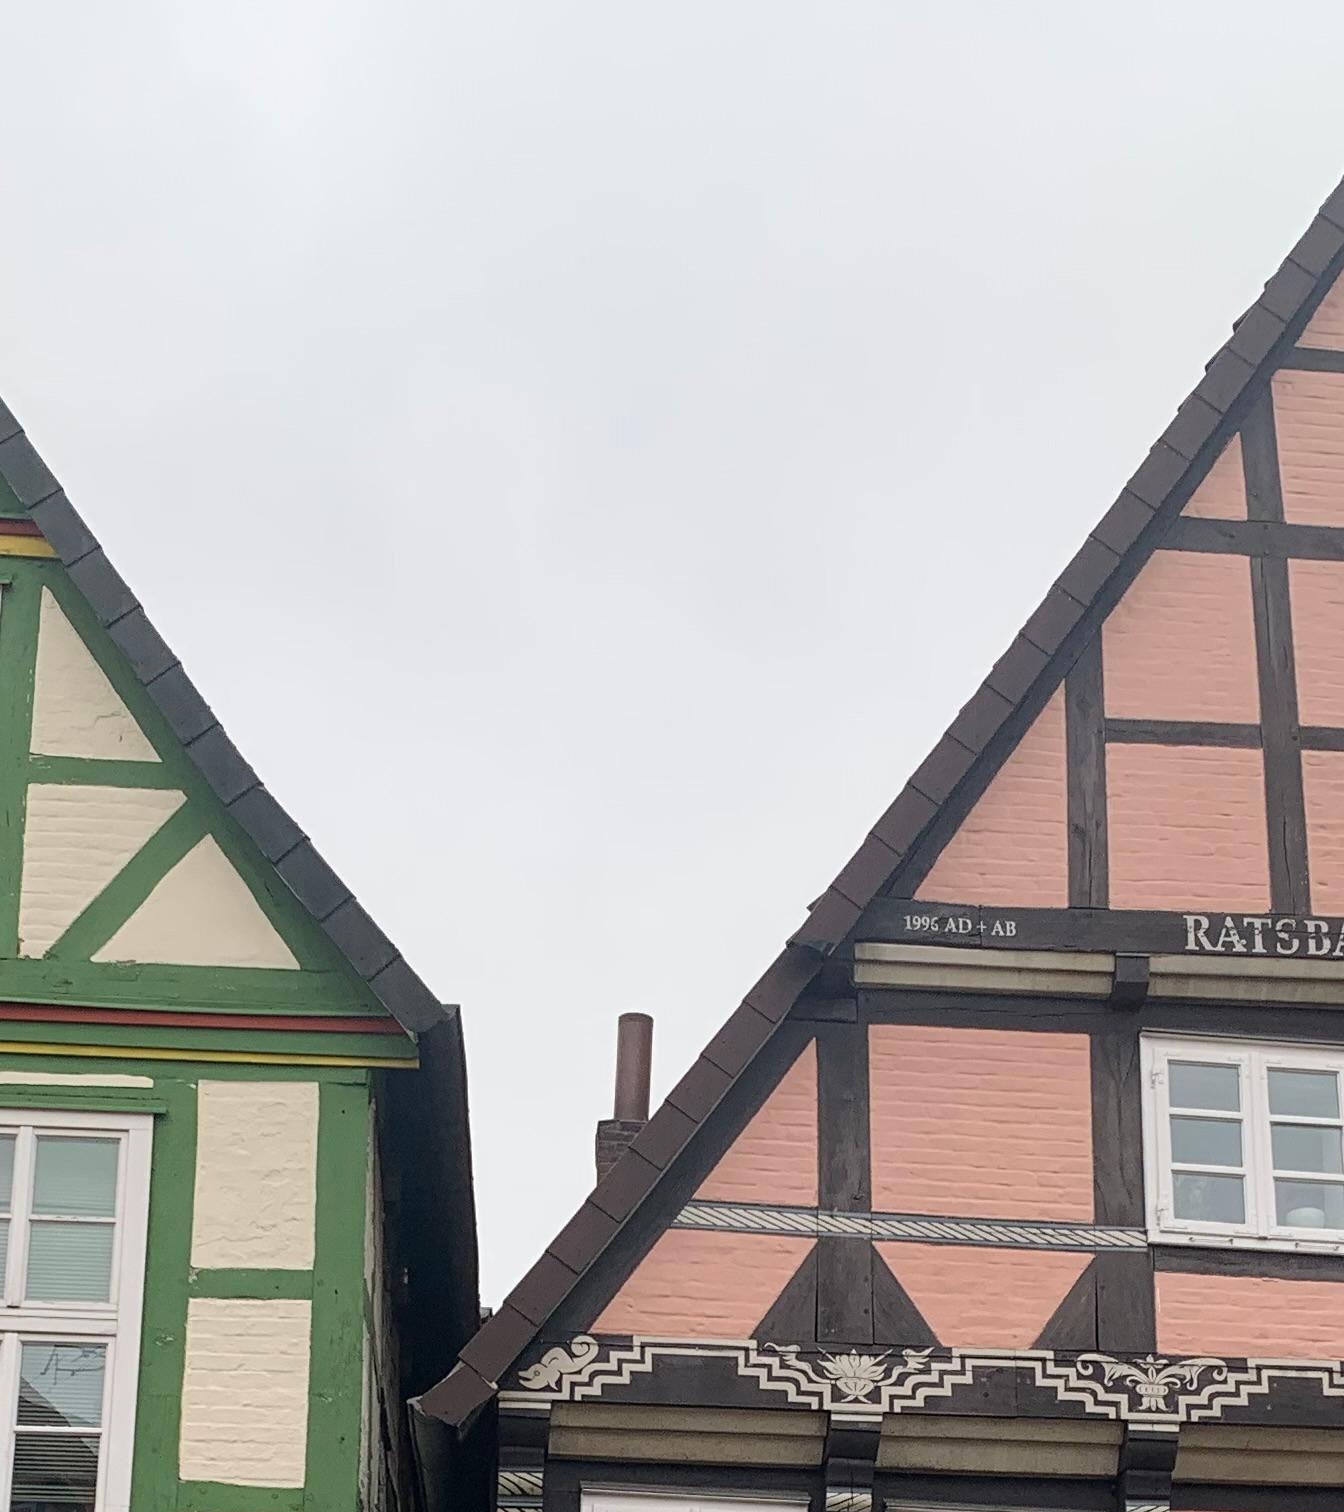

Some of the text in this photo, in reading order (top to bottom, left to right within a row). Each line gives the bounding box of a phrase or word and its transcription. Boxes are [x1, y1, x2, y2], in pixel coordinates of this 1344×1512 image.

[903, 915, 939, 931] 1996
[944, 918, 973, 933] AD
[991, 920, 1017, 936] AB
